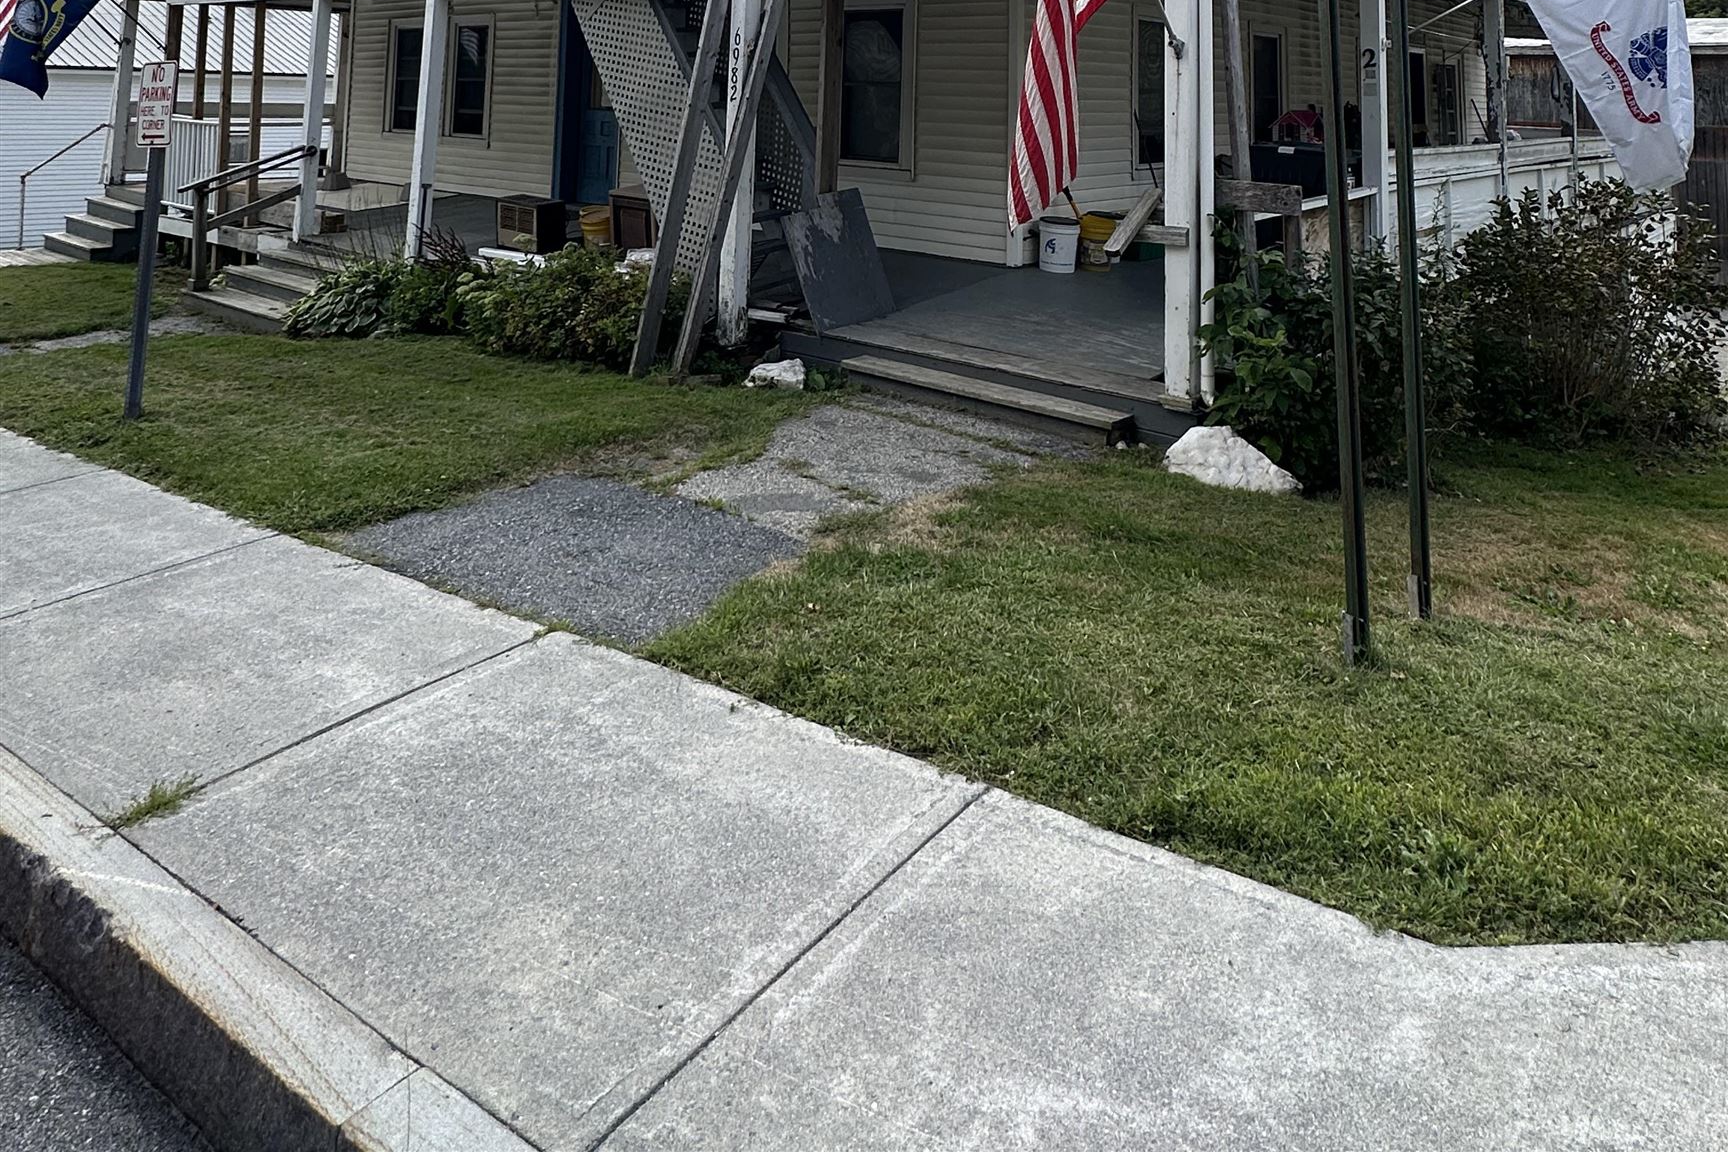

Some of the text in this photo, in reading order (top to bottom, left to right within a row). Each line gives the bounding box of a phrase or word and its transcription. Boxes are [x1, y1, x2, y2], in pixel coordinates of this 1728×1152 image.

[730, 27, 741, 102] 6982
[1362, 48, 1377, 69] 2
[151, 67, 165, 83] NO
[1591, 33, 1612, 62] UNITED
[1611, 62, 1631, 93] STATES
[1625, 94, 1645, 120] ARMY
[1601, 71, 1616, 91] 1775
[141, 86, 171, 101] PARKING
[141, 105, 169, 117] HERE TO
[142, 120, 165, 130] CORNER
